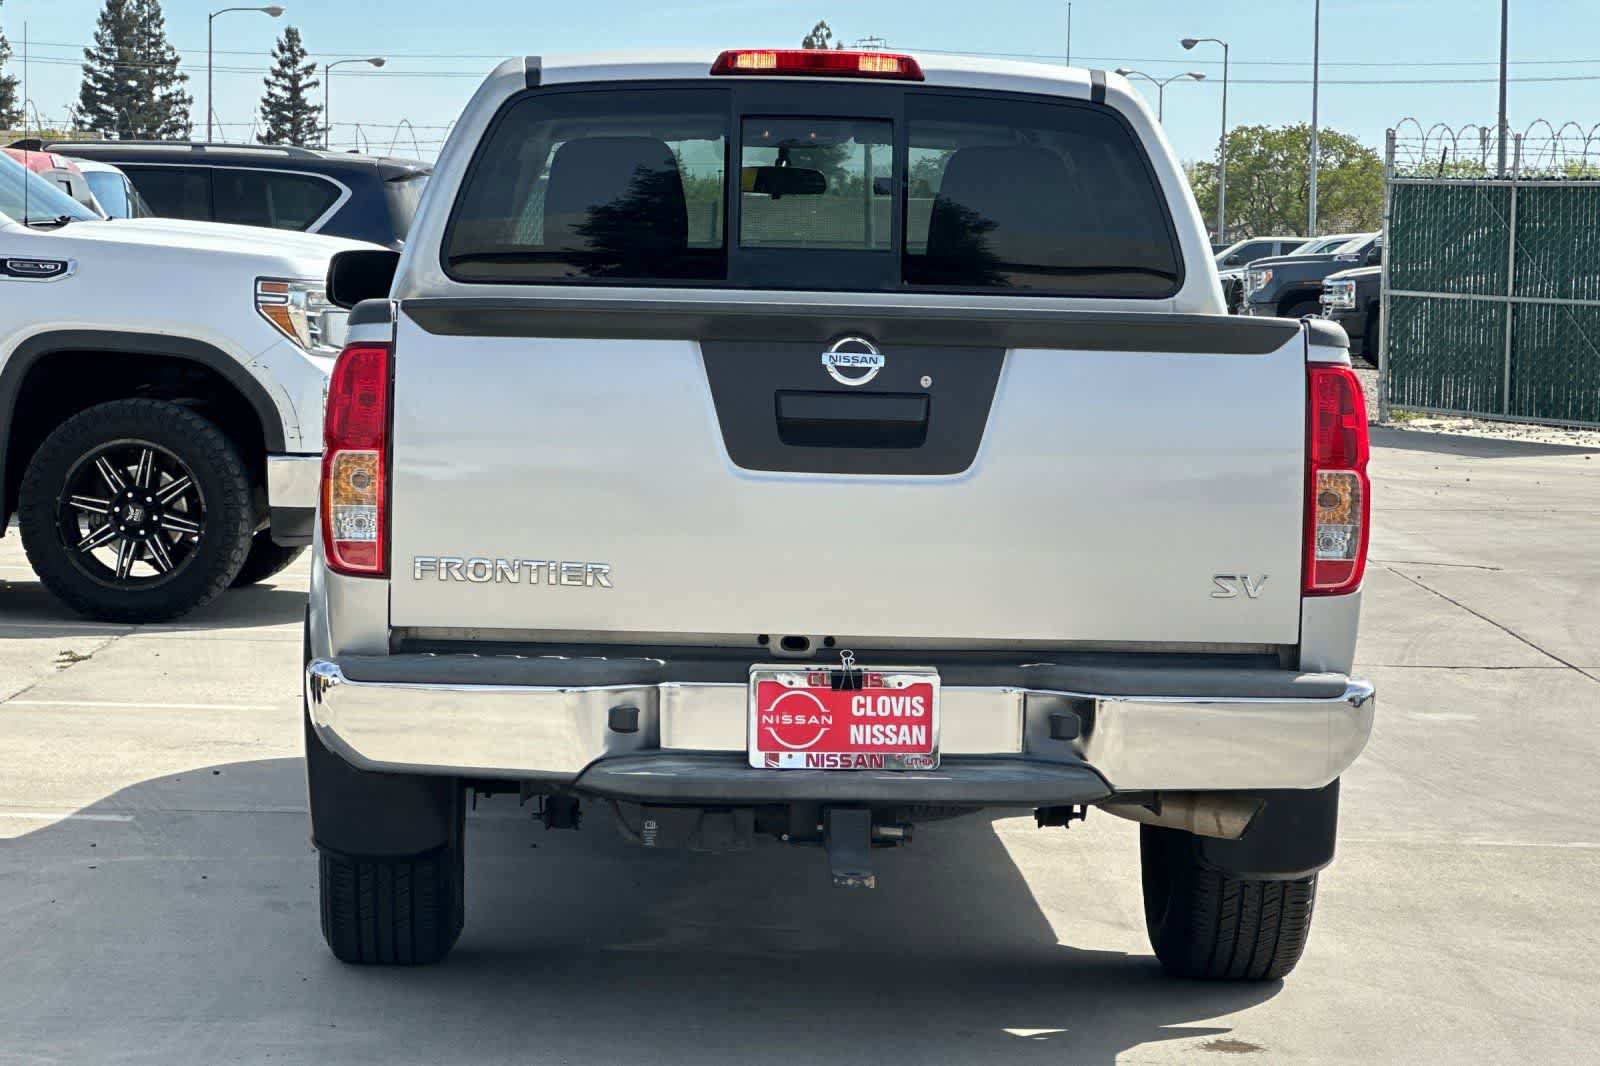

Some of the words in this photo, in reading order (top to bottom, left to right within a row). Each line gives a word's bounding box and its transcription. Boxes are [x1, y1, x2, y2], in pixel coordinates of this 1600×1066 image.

[828, 354, 878, 365] NISSAN
[413, 556, 613, 588] FRONTIER
[1210, 575, 1268, 599] SV
[806, 672, 883, 688] CLIS
[851, 695, 925, 717] CLOVIS
[761, 714, 832, 725] NISSAN
[850, 724, 926, 745] NISSAN
[805, 753, 885, 768] NISSAN
